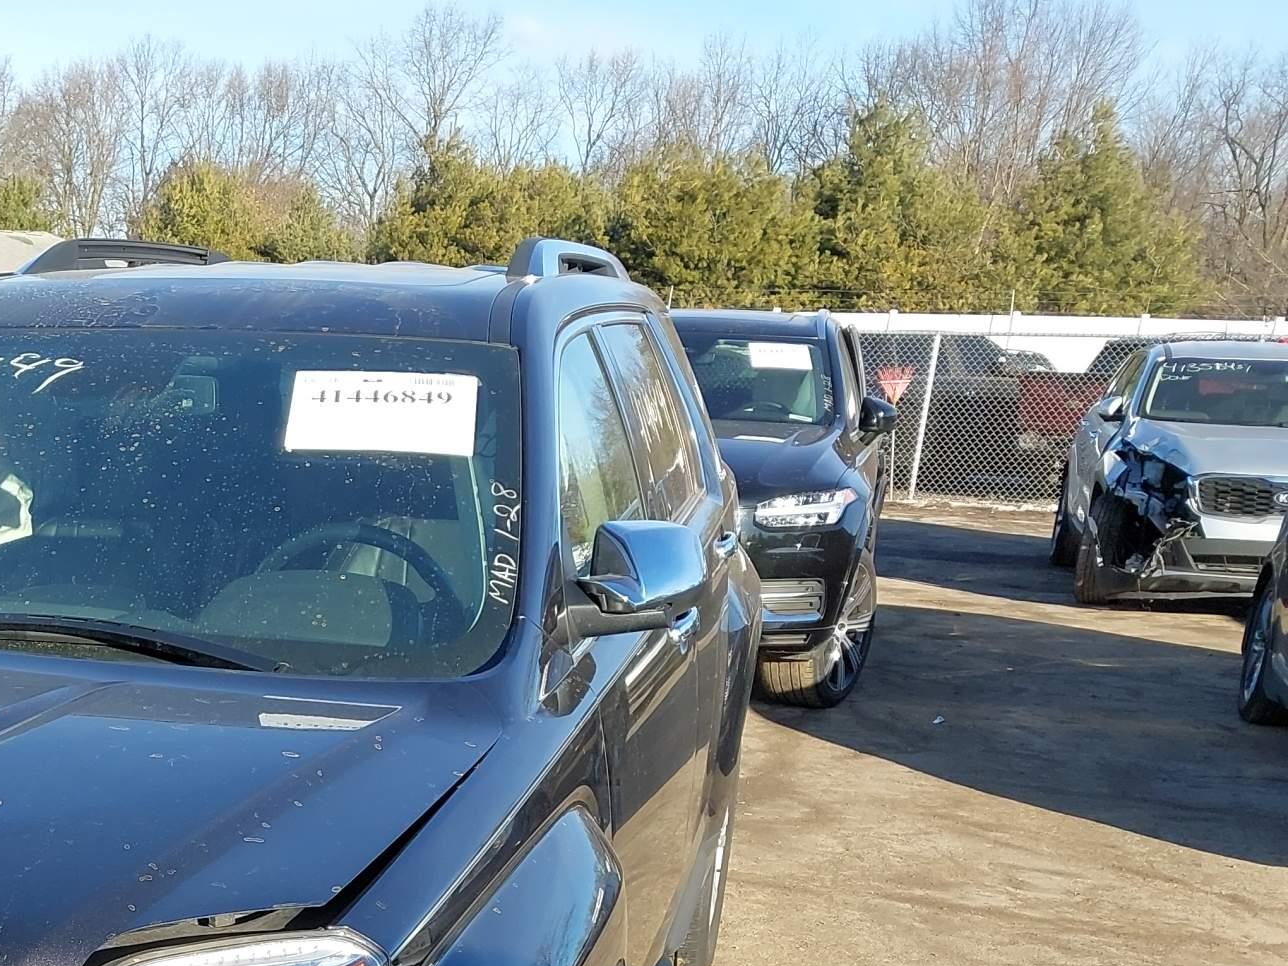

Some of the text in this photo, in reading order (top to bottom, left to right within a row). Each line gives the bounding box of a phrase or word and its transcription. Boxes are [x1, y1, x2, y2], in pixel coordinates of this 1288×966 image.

[312, 389, 453, 404] 41446849
[489, 482, 521, 604] MAD 1-28
